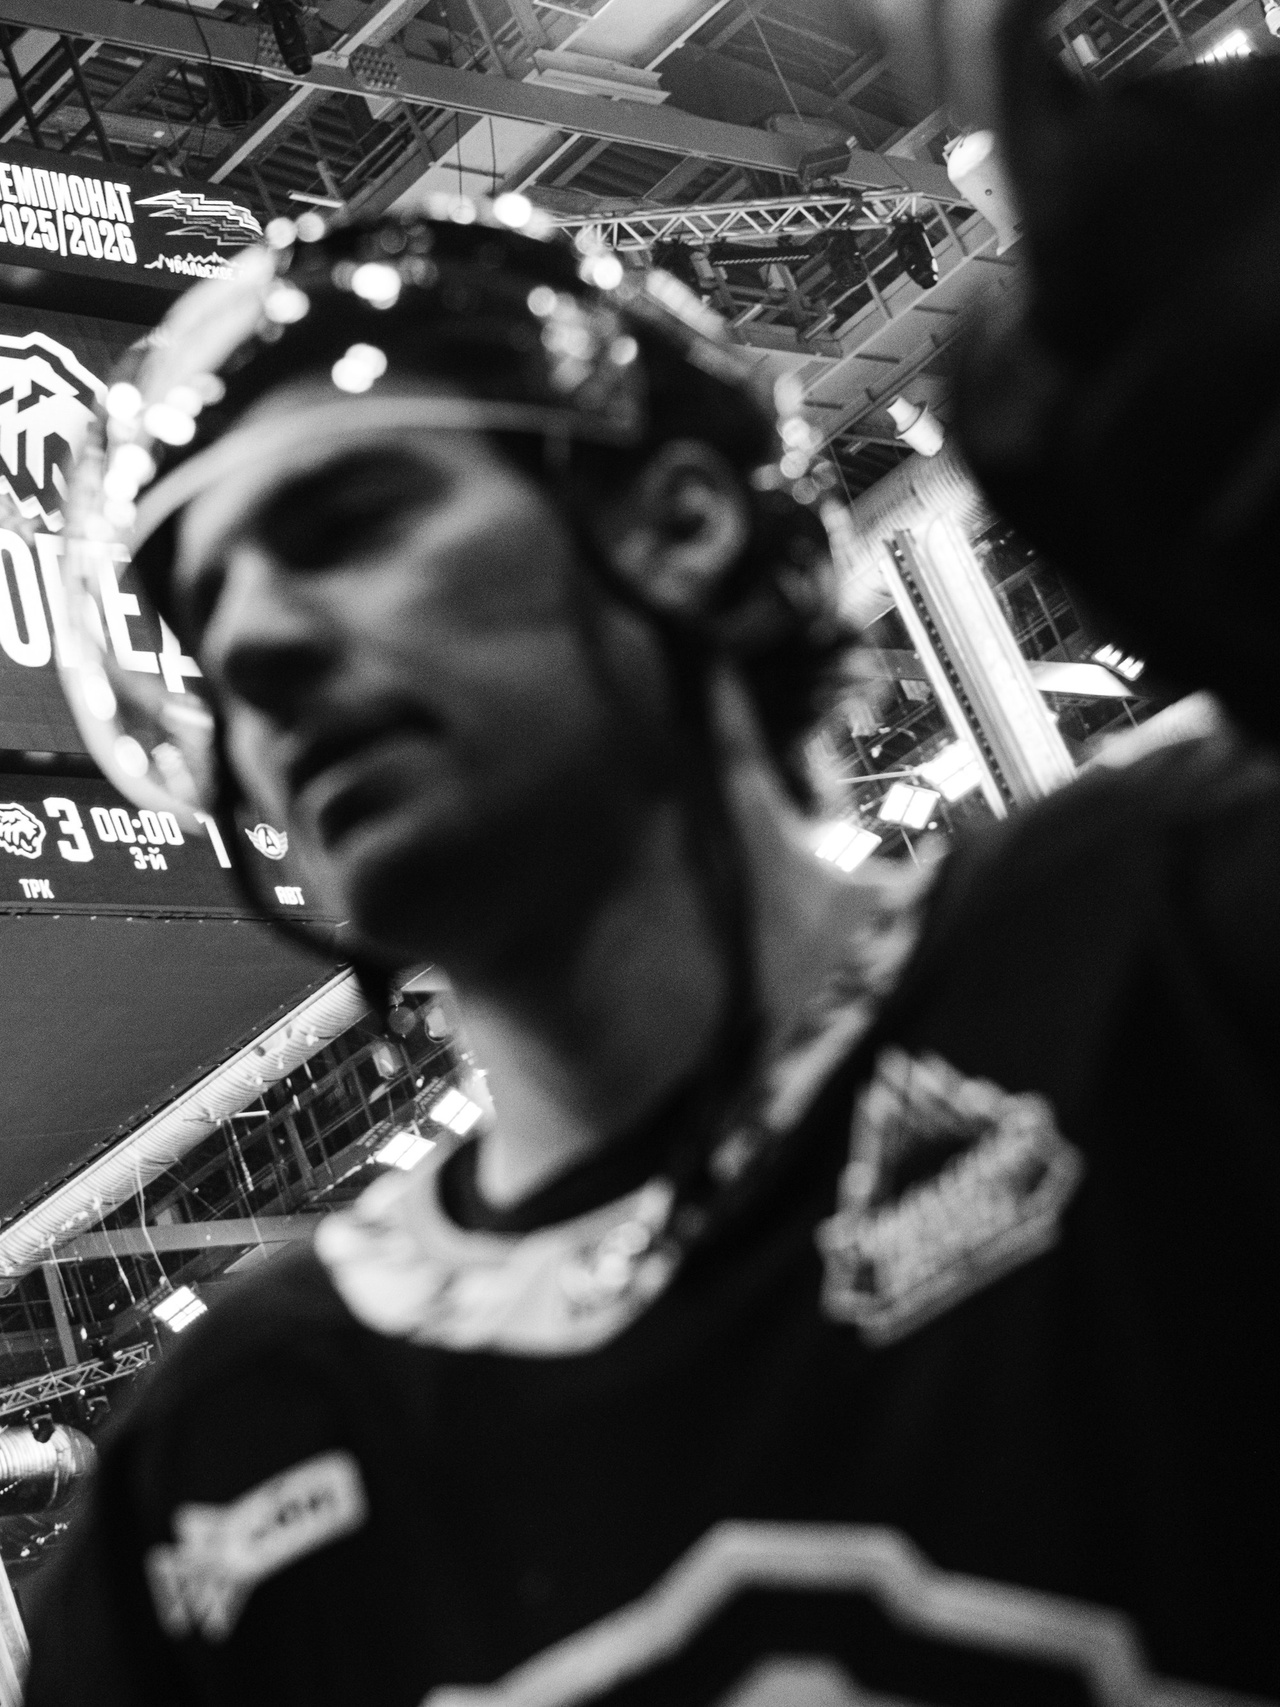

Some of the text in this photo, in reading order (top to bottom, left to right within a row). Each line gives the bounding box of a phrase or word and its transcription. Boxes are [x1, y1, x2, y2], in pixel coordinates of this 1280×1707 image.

[42, 797, 232, 868] 3 00:00 1
[19, 879, 55, 899] ТРК
[274, 886, 305, 905] АВТ
